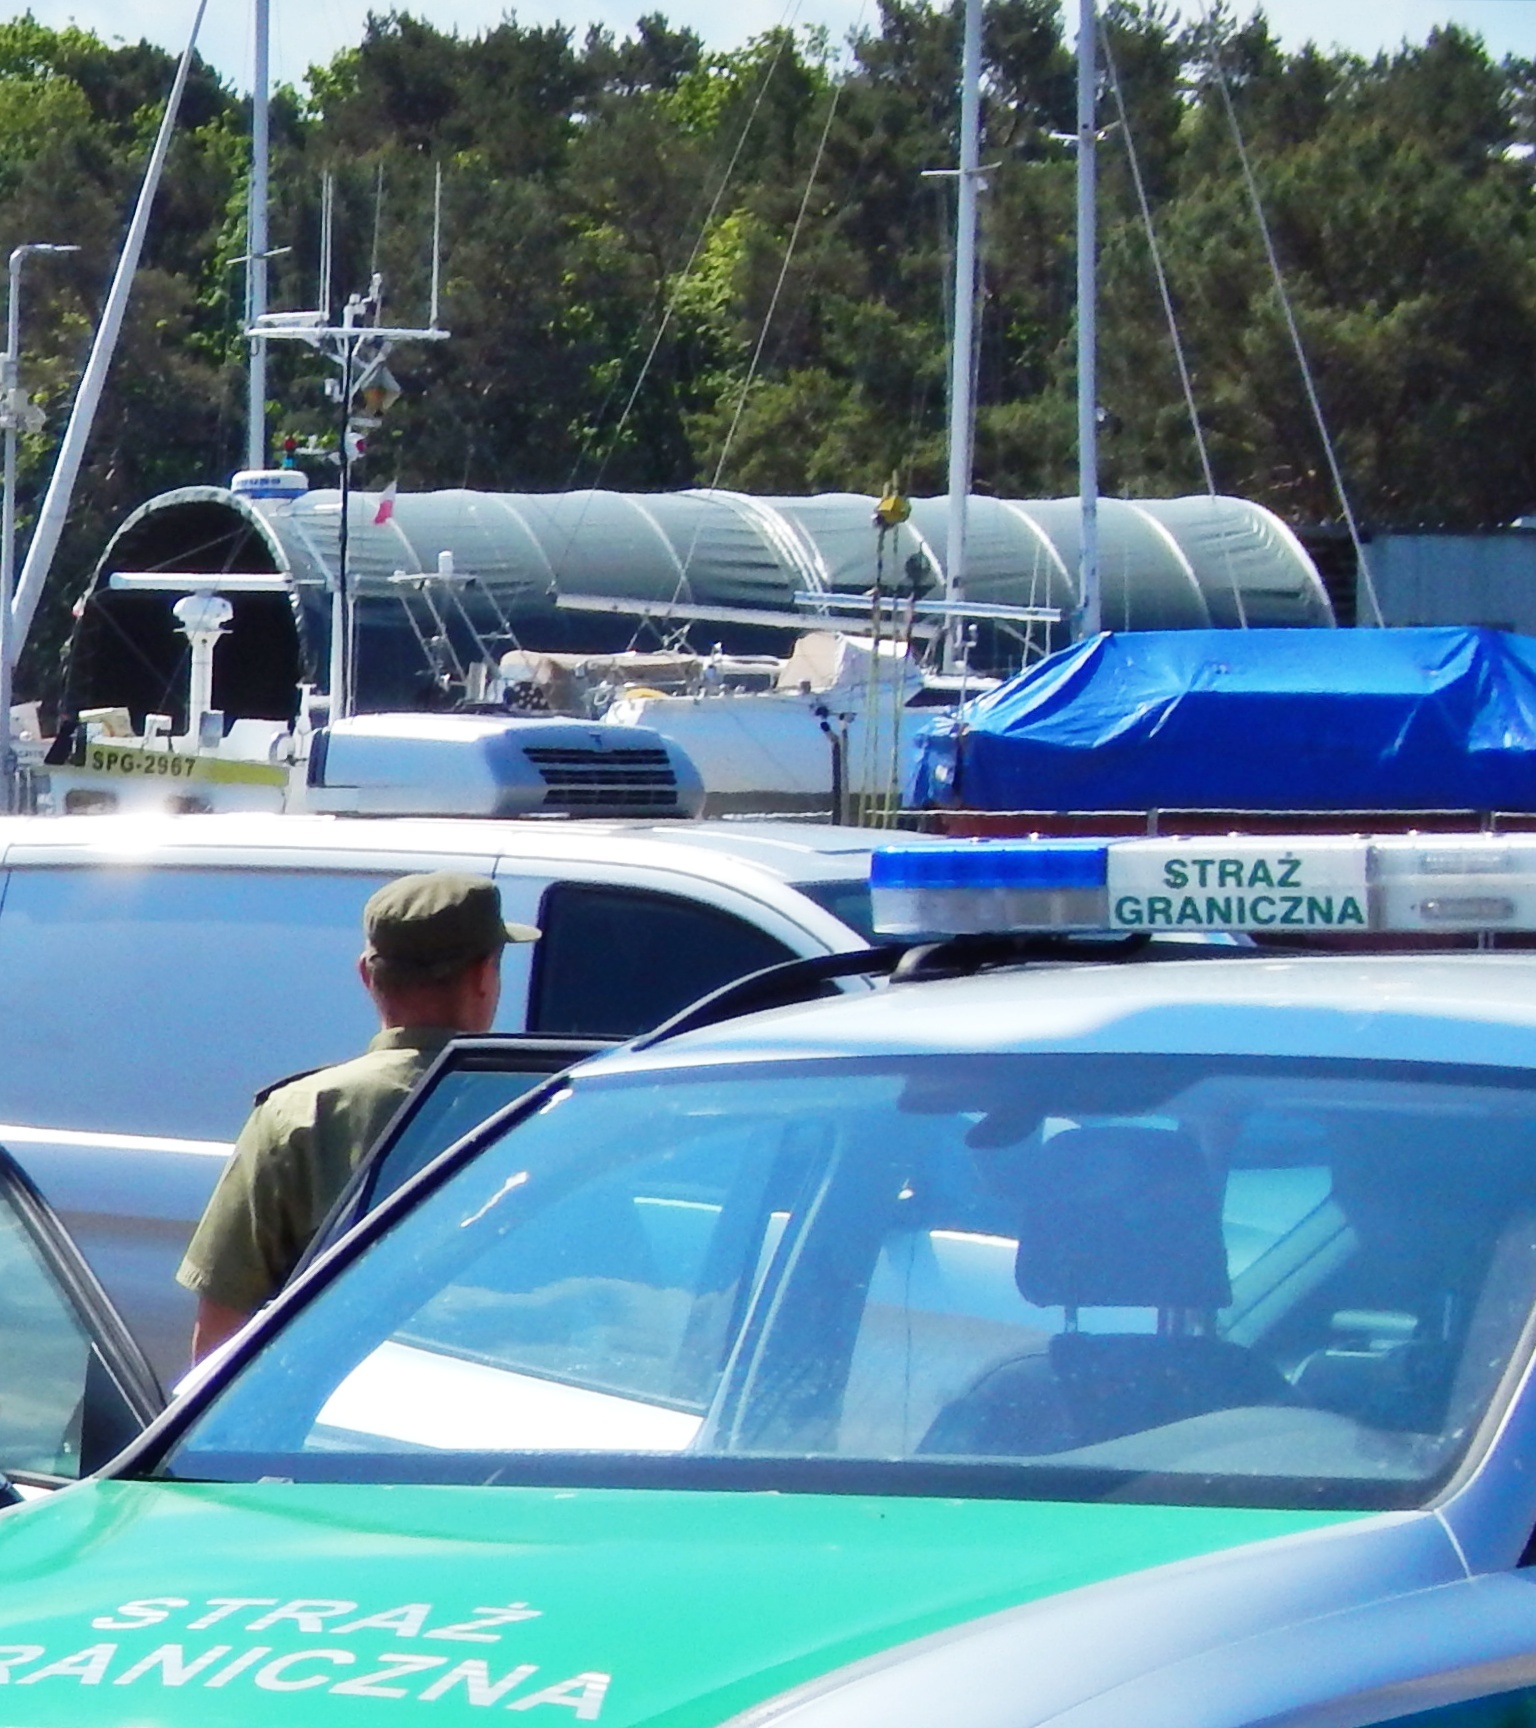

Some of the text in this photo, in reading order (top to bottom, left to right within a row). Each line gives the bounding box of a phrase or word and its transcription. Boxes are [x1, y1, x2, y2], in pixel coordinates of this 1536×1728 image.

[92, 750, 196, 777] SPG-2967
[1163, 852, 1302, 889] STRAŻ
[1115, 896, 1364, 925] GRANICZNA
[91, 1597, 543, 1644] STRAŻ
